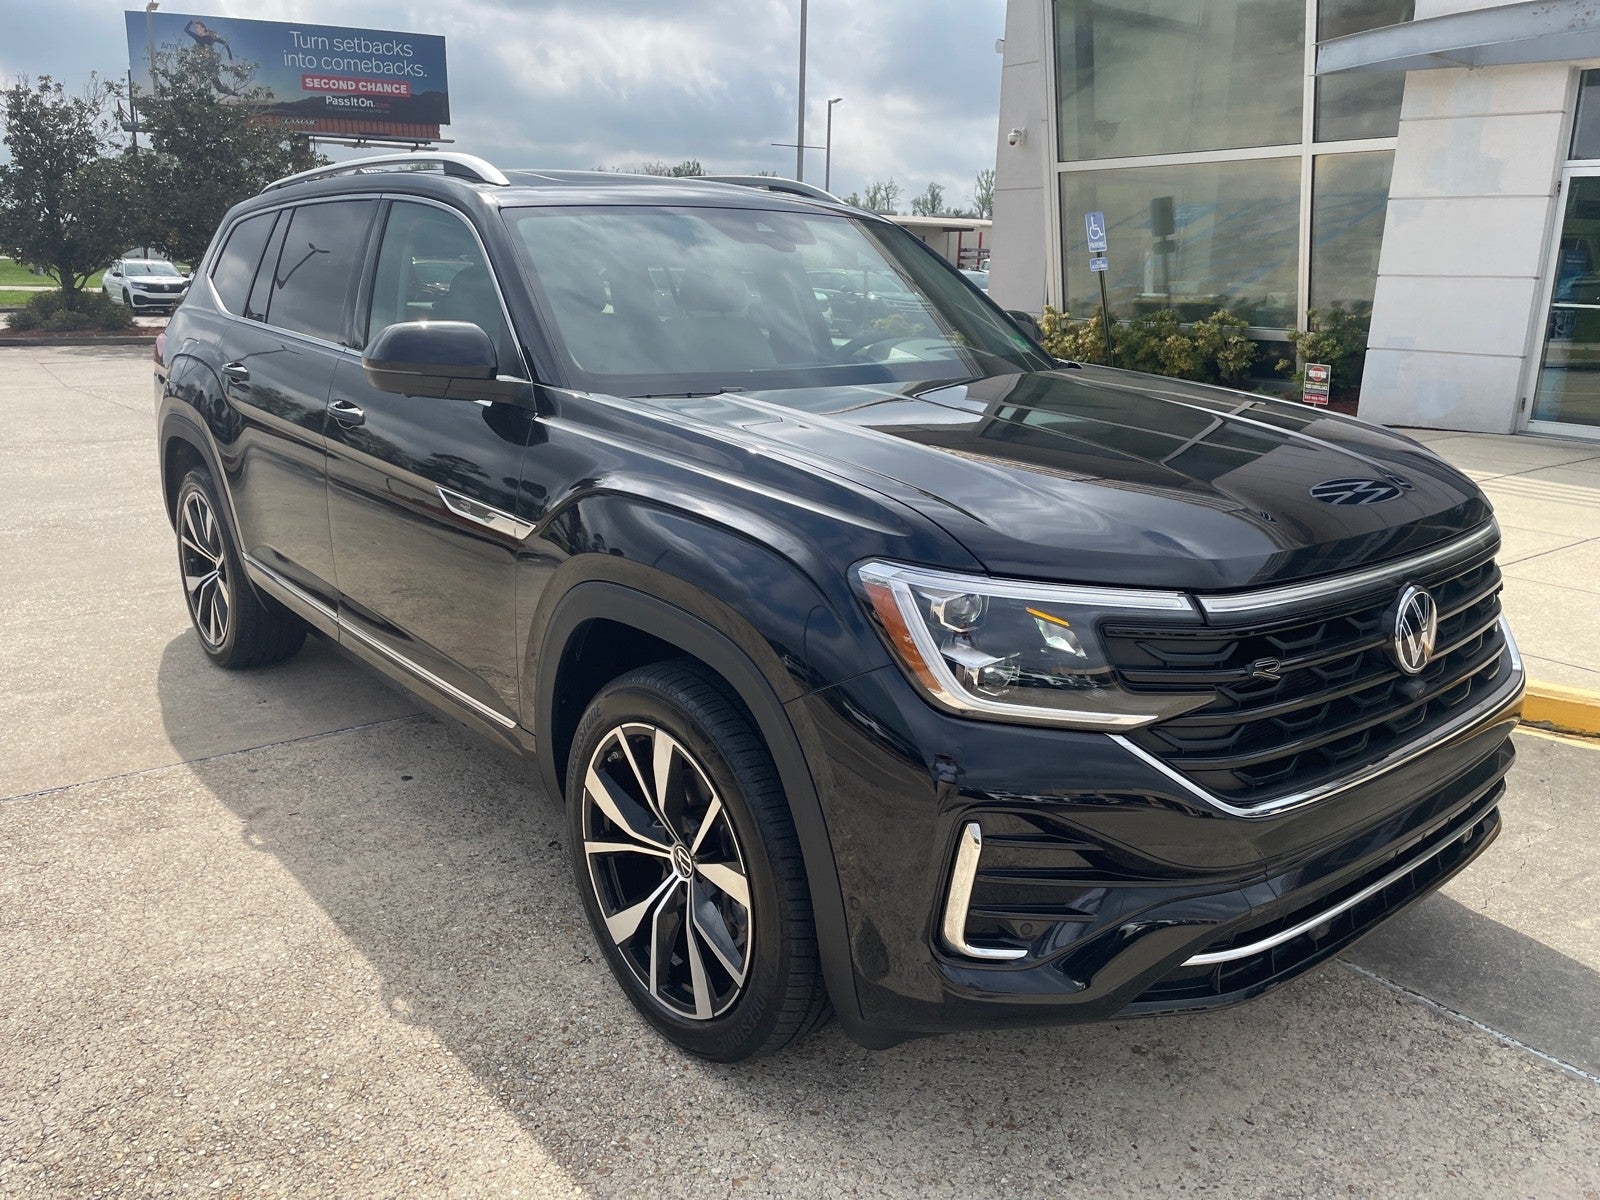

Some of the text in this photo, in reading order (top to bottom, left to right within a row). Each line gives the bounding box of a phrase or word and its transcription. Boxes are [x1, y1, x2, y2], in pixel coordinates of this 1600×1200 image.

[289, 31, 414, 57] Turn setbacks
[283, 50, 428, 77] into comebacks.
[305, 78, 408, 94] SECOND CHANCE
